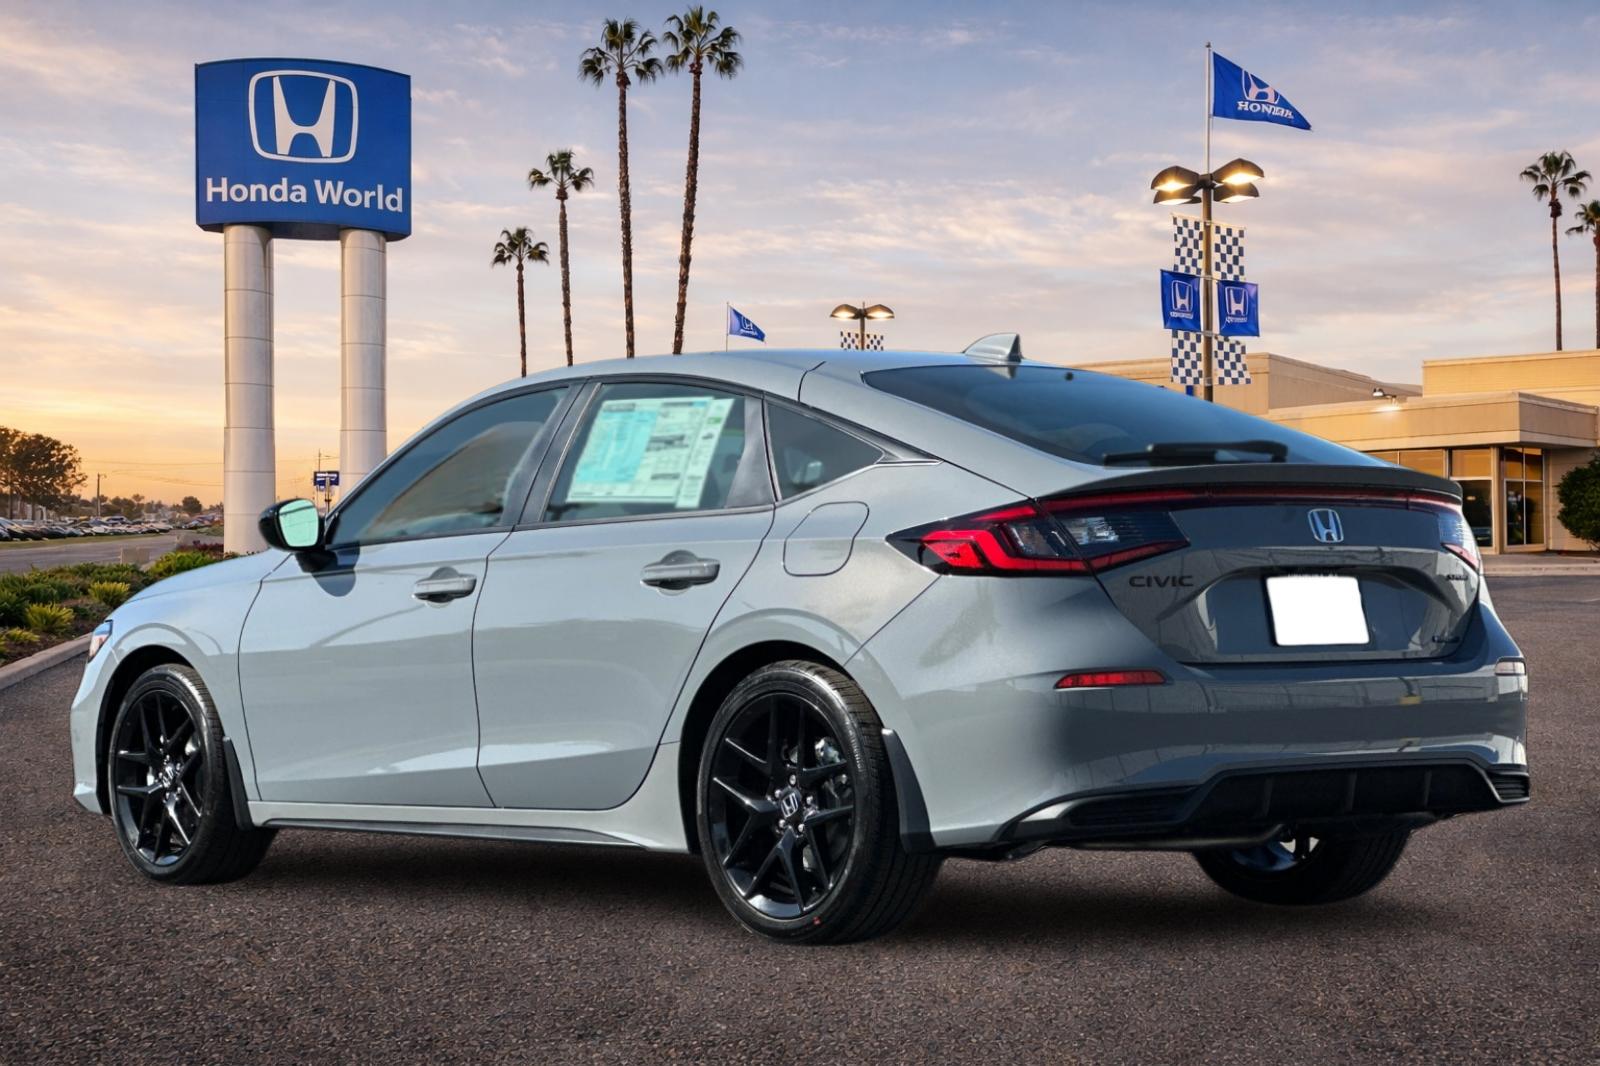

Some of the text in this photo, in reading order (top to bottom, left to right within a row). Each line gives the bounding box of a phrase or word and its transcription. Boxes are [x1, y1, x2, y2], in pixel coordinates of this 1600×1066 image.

[206, 177, 403, 213] Honda World
[1129, 575, 1194, 588] CIVIC
